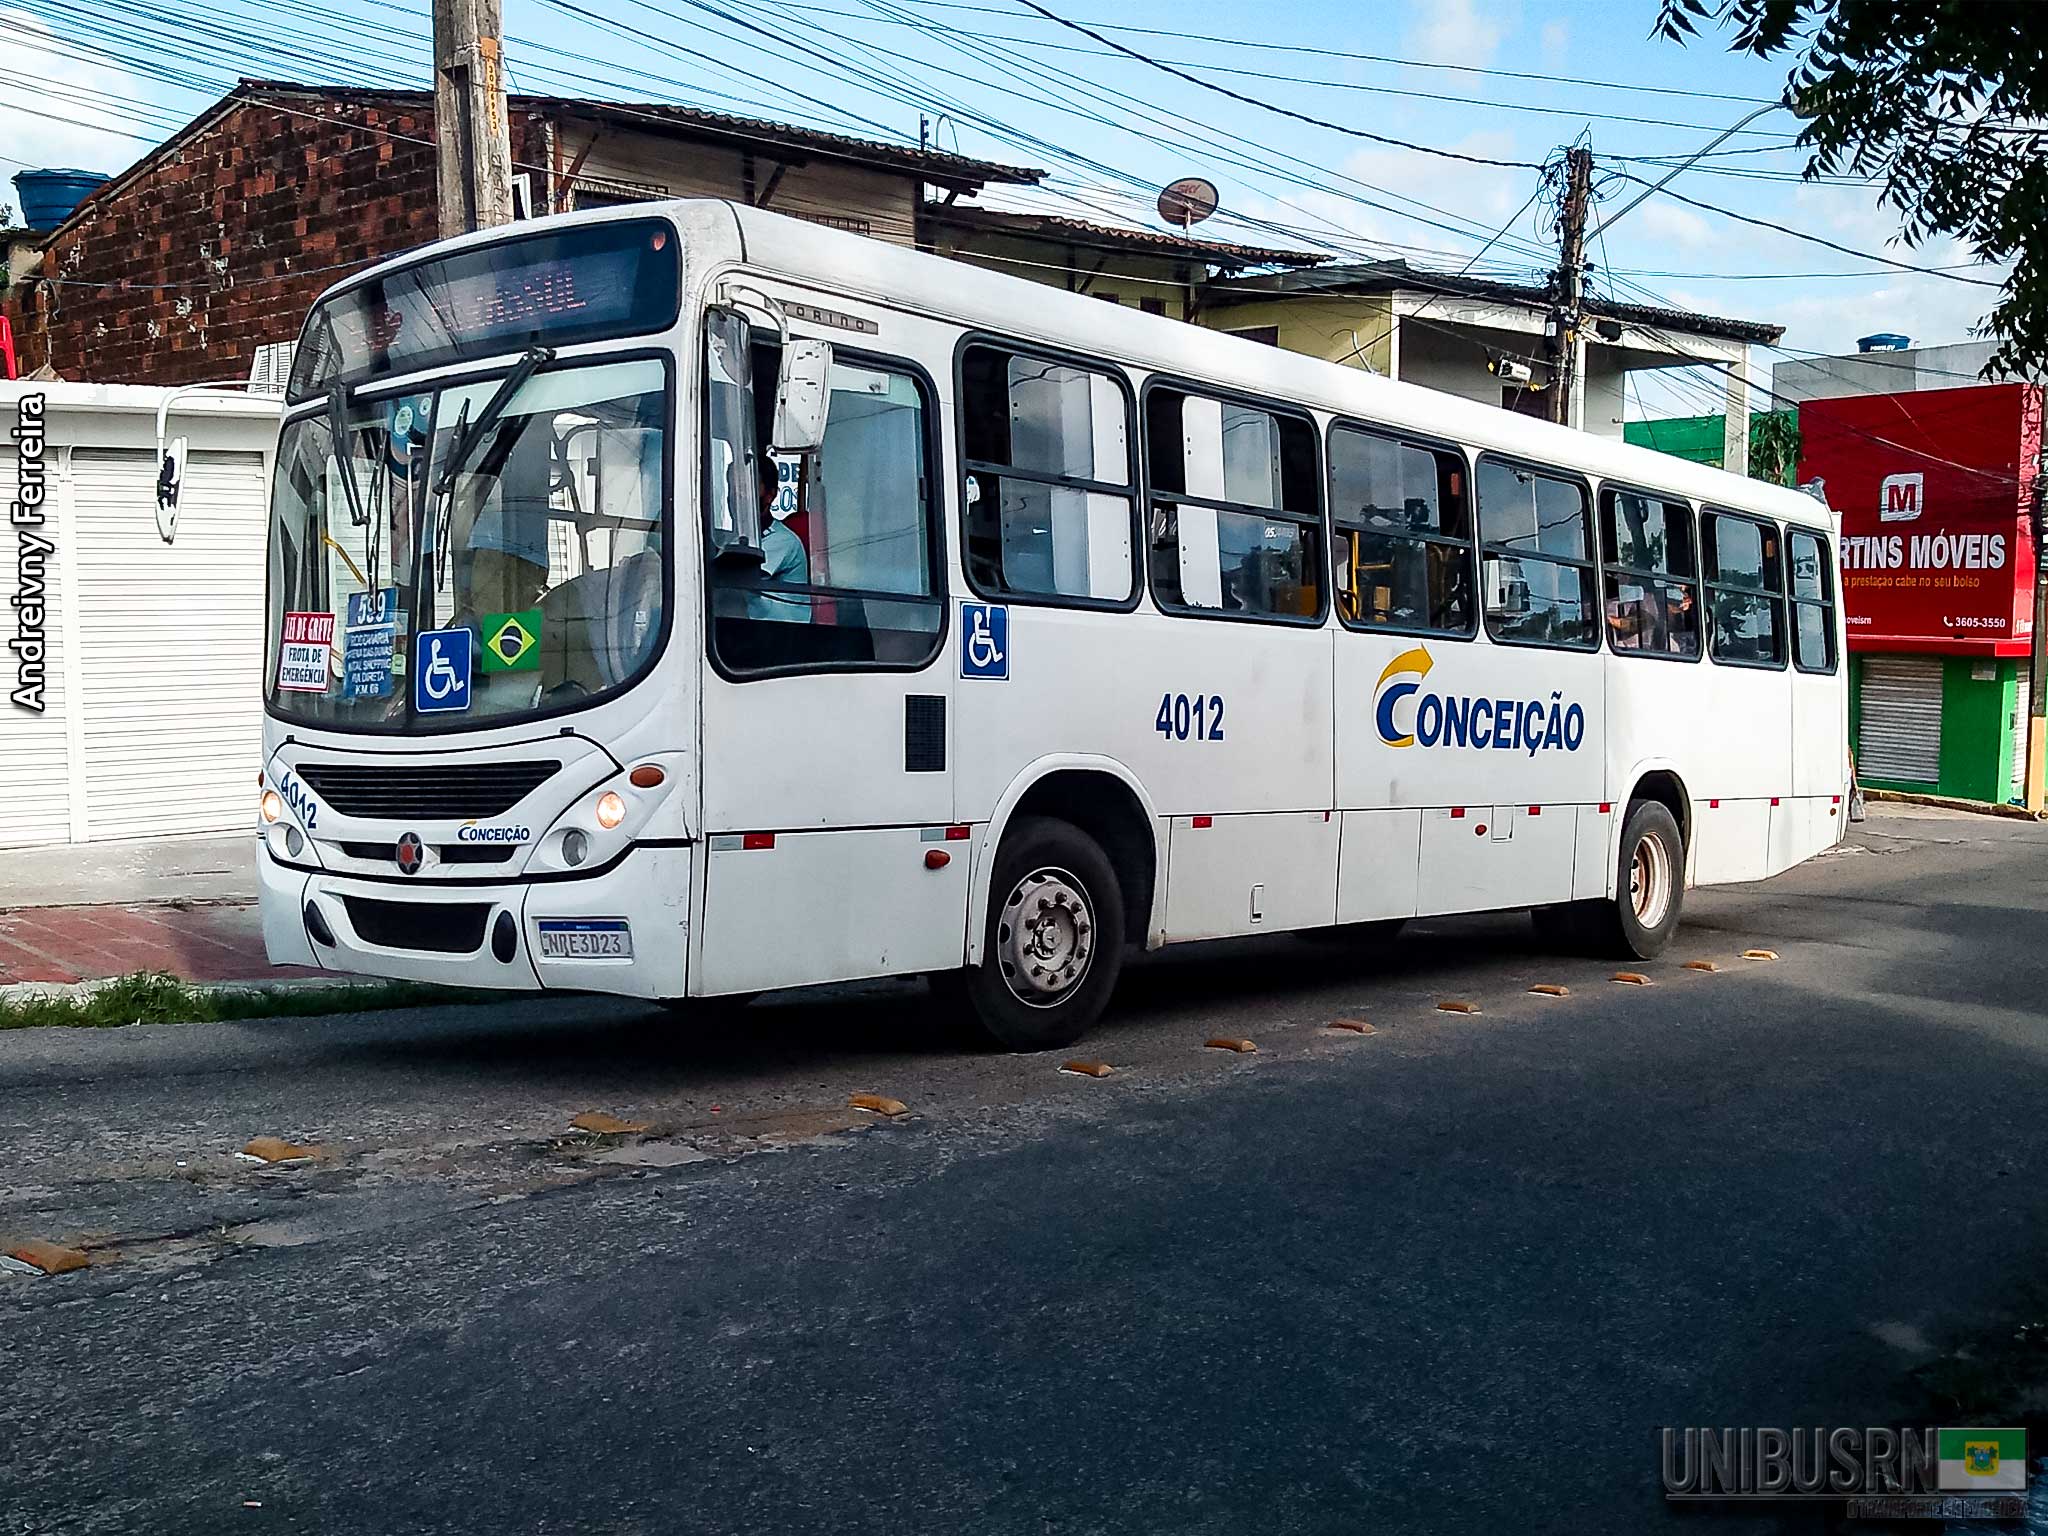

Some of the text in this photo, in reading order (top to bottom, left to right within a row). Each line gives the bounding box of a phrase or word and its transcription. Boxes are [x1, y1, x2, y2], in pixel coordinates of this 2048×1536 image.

[1887, 483, 1916, 513] M
[1910, 527, 2006, 570] MÓVEIS
[1895, 574, 1917, 587] cabe
[1919, 576, 1931, 587] no
[1934, 576, 1951, 587] seu
[1953, 574, 1980, 588] bolso
[296, 616, 307, 641] DE
[1955, 616, 2006, 628] 3605-3550
[288, 647, 323, 664] FROTA DE
[281, 663, 325, 684] EMERGÊNCIA
[1155, 693, 1224, 741] 4012
[1376, 682, 1585, 758] CONCEIÇÃO
[280, 771, 317, 829] 4012
[457, 824, 530, 843] CONCEIÇÃO
